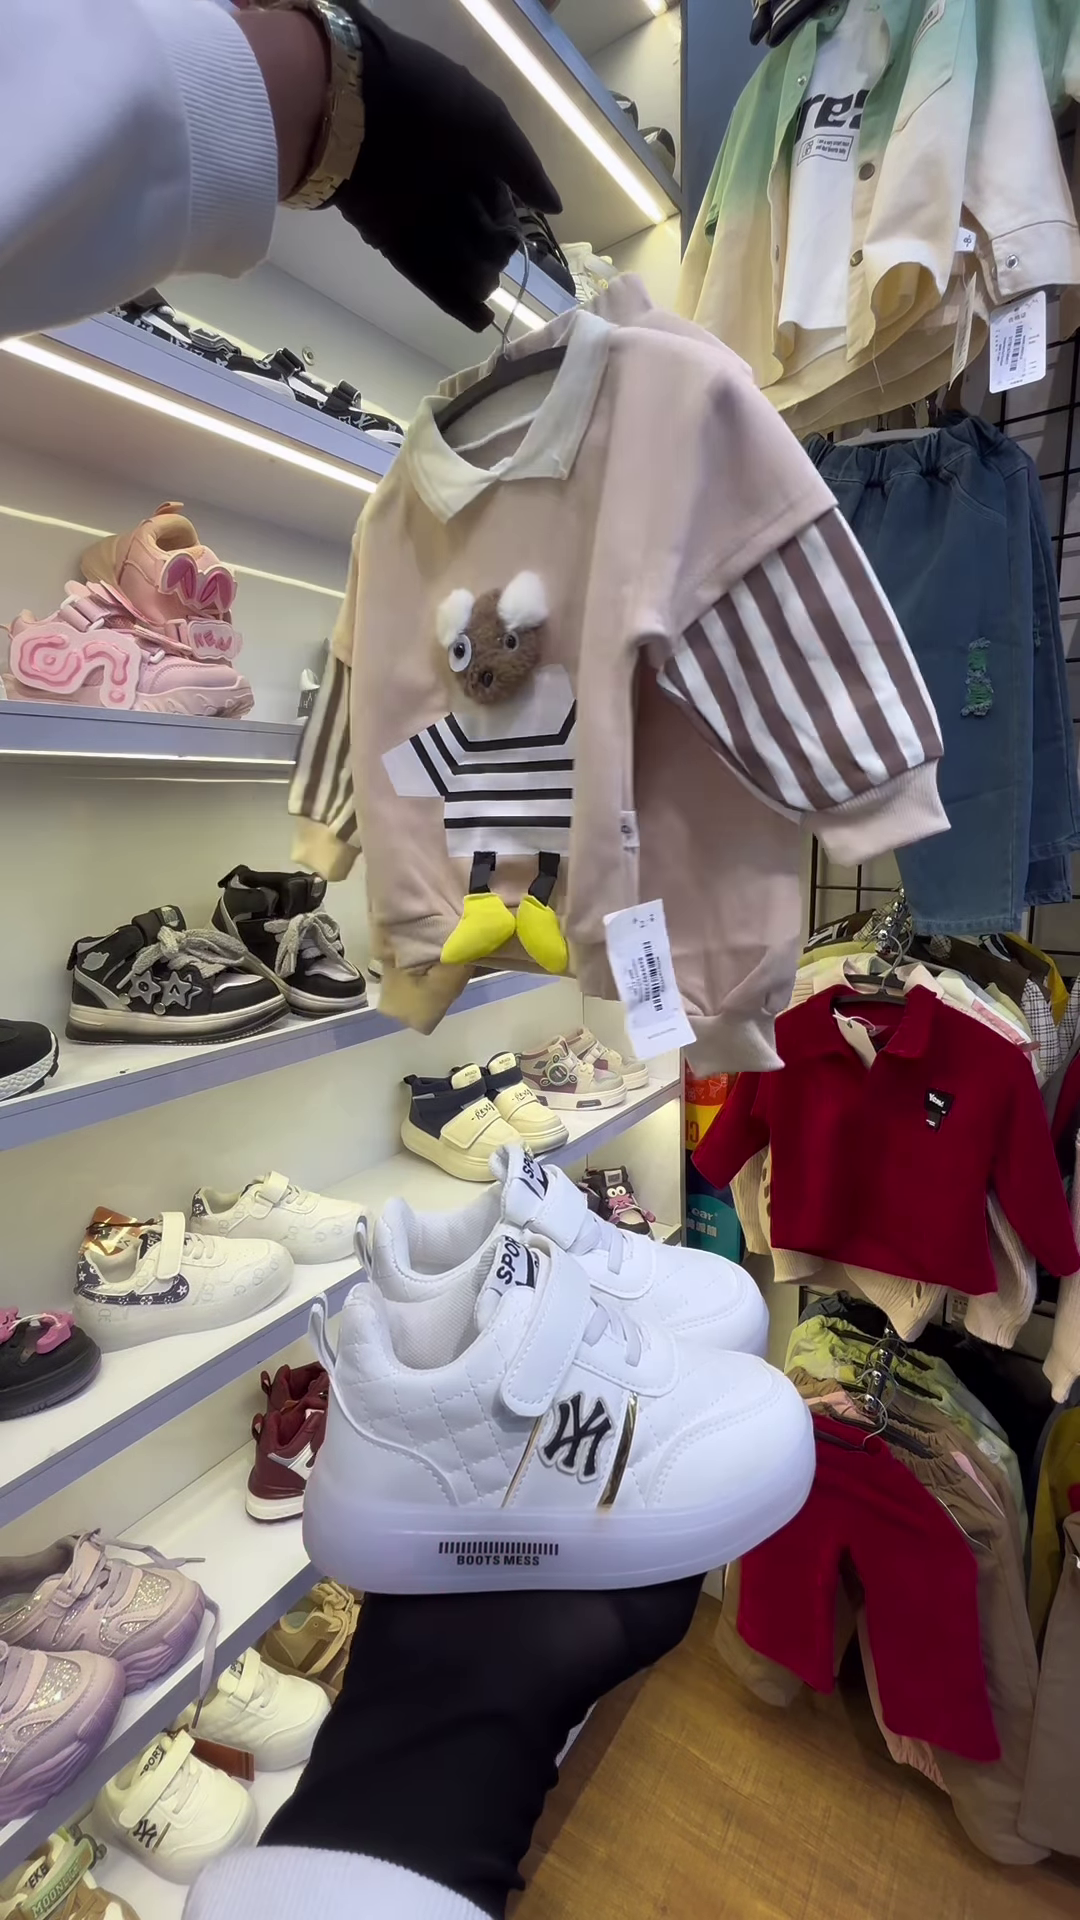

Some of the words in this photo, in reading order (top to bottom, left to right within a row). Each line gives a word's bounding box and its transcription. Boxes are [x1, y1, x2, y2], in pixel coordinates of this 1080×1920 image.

[544, 1394, 612, 1477] NY
[457, 1555, 500, 1566] BOOTS
[503, 1555, 540, 1566] MESS
[140, 1745, 164, 1776] PORT
